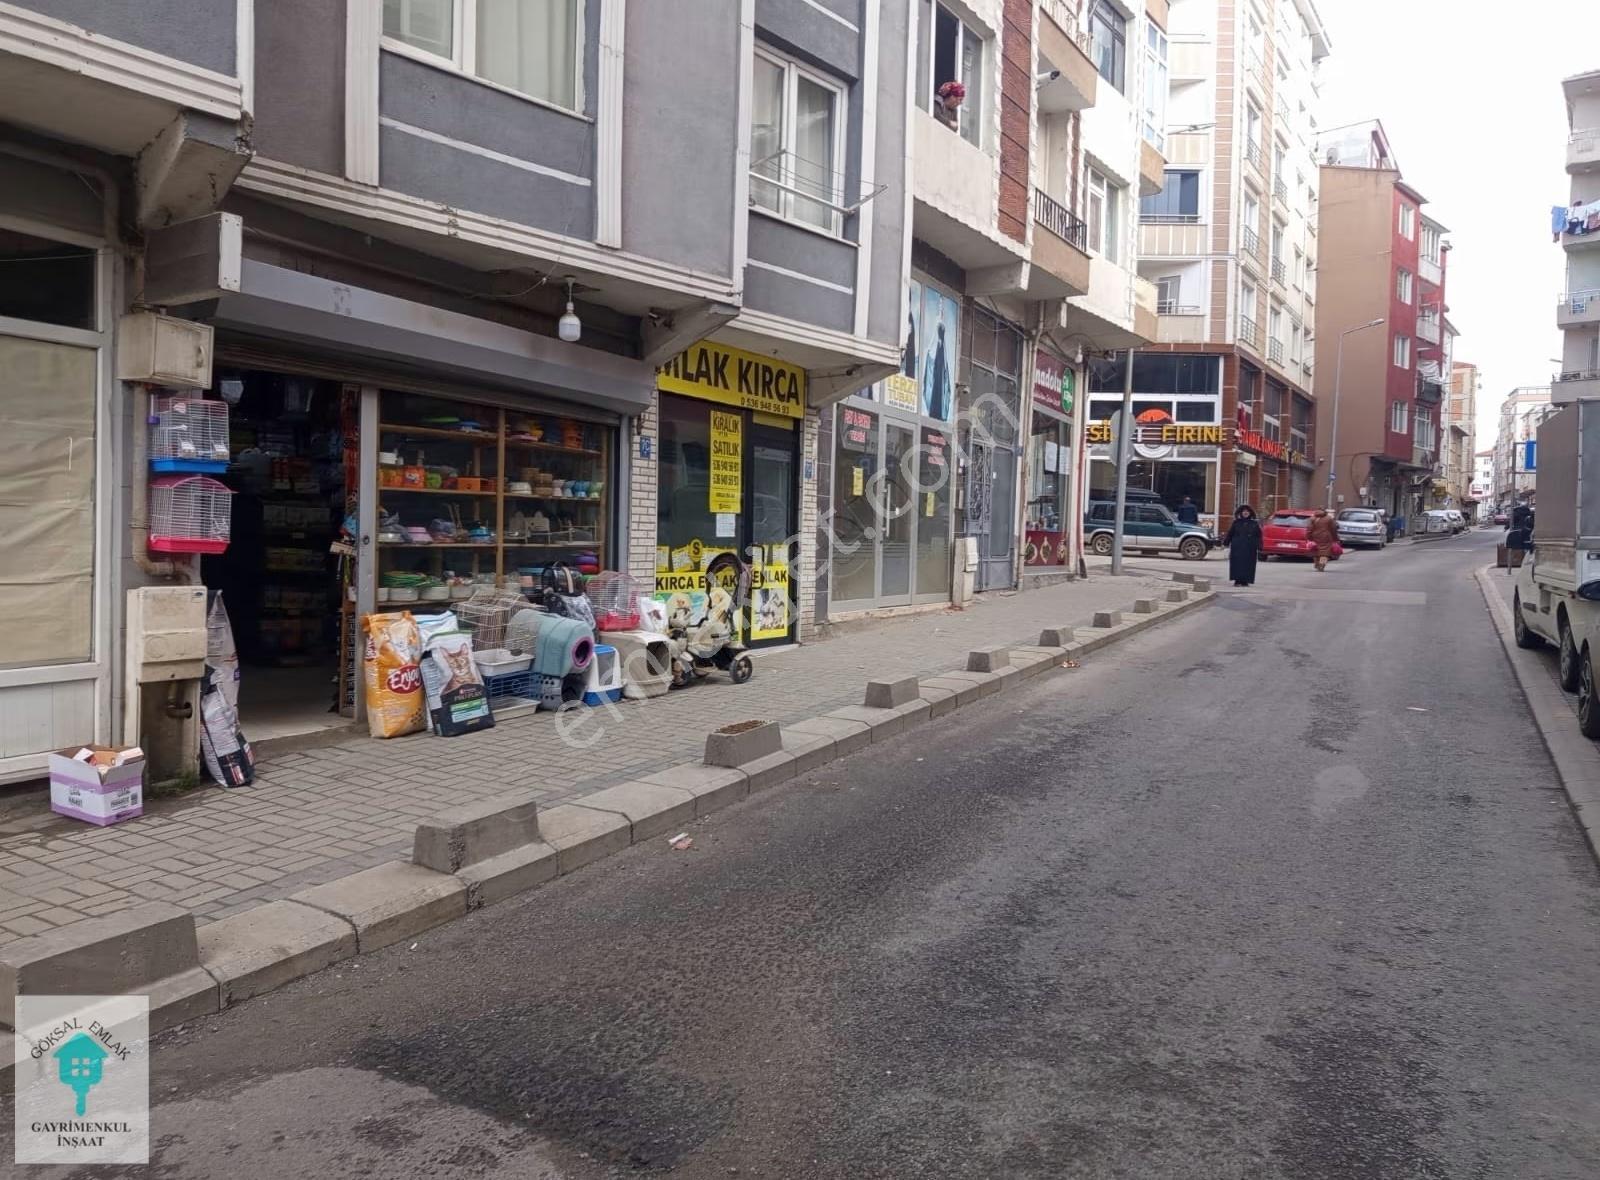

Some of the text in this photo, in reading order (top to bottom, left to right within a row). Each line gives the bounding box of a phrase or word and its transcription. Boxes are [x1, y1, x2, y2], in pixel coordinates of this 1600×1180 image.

[738, 358, 800, 405] KIRCA
[1089, 419, 1146, 443] SİT
[713, 440, 739, 457] SATILIK
[655, 574, 737, 591] KIRCA ELAK
[390, 666, 422, 690] Enjoy
